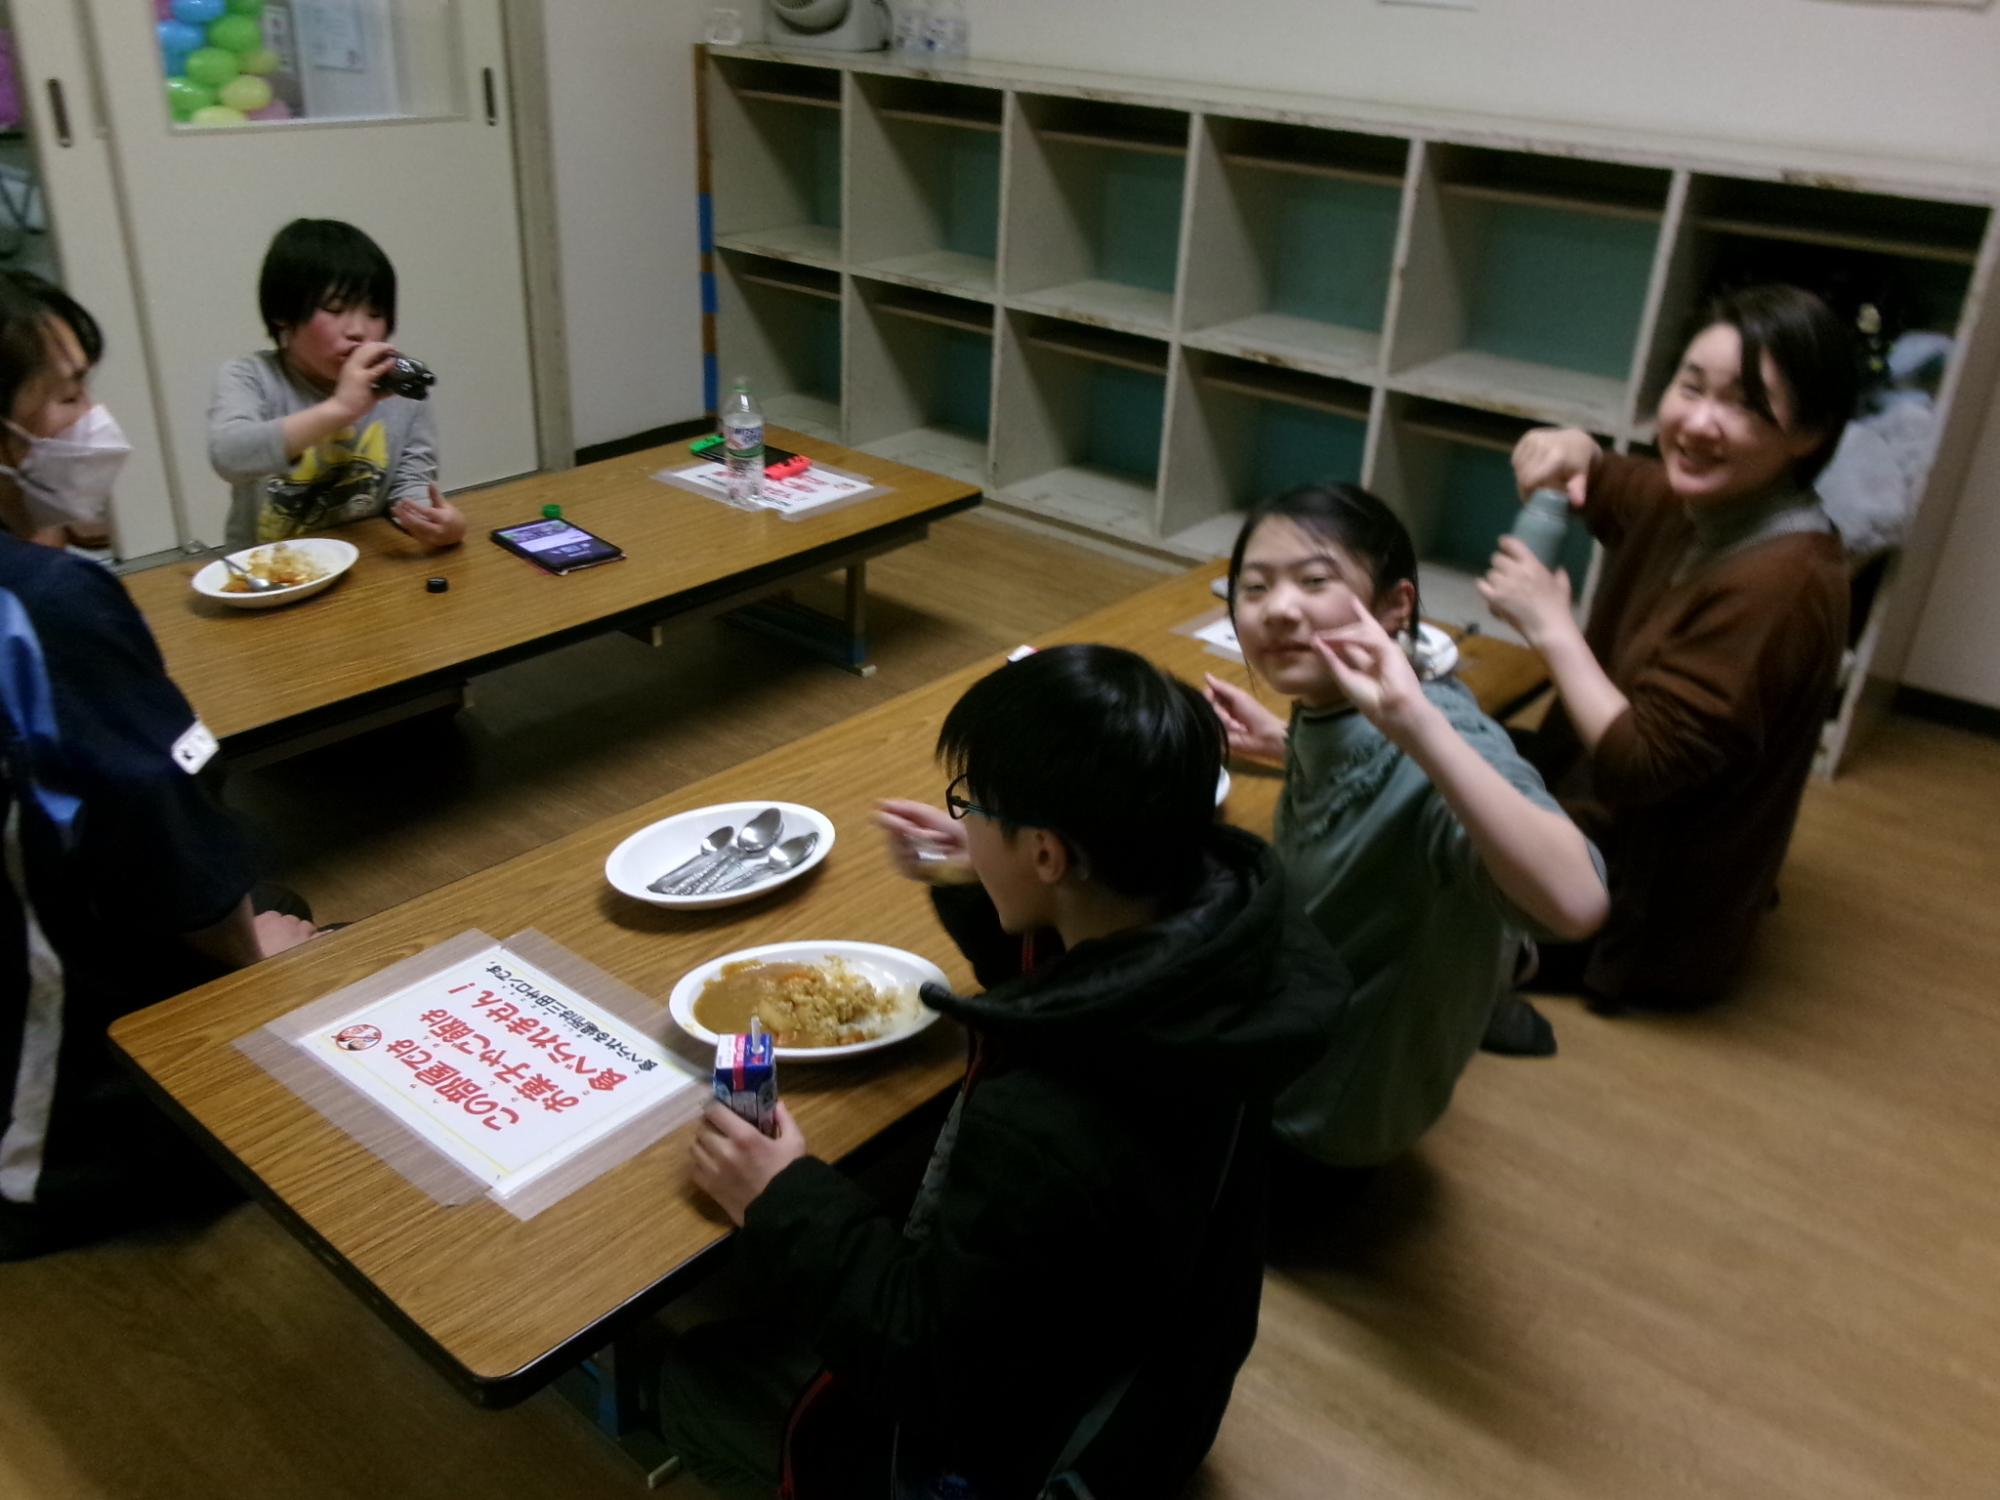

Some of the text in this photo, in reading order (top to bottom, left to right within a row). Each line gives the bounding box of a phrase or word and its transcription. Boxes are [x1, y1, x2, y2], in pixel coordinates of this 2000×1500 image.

[387, 1038, 521, 1131] この部屋では
[419, 1008, 581, 1114] お菓子やご飯は
